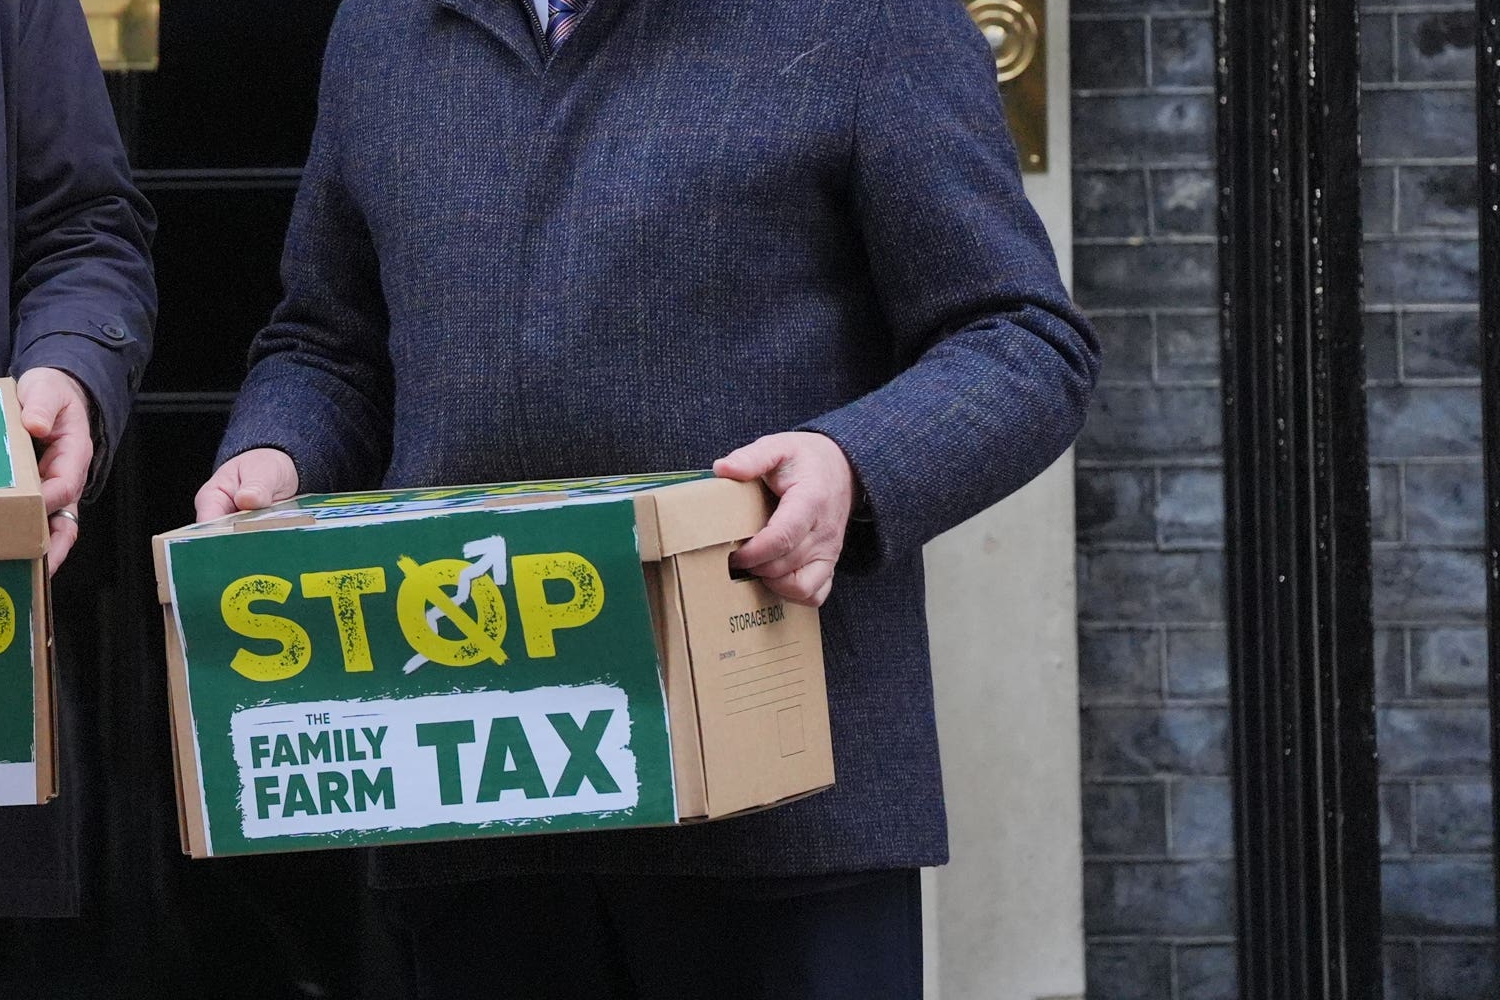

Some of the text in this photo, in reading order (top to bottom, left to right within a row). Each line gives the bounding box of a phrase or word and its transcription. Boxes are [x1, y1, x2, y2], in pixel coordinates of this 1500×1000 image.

[219, 551, 605, 682] STOP
[729, 603, 785, 633] STORAGE BOX
[305, 712, 331, 726] THE
[250, 725, 388, 769] FAMILY
[416, 708, 622, 806] TAX
[254, 767, 396, 820] FARM
